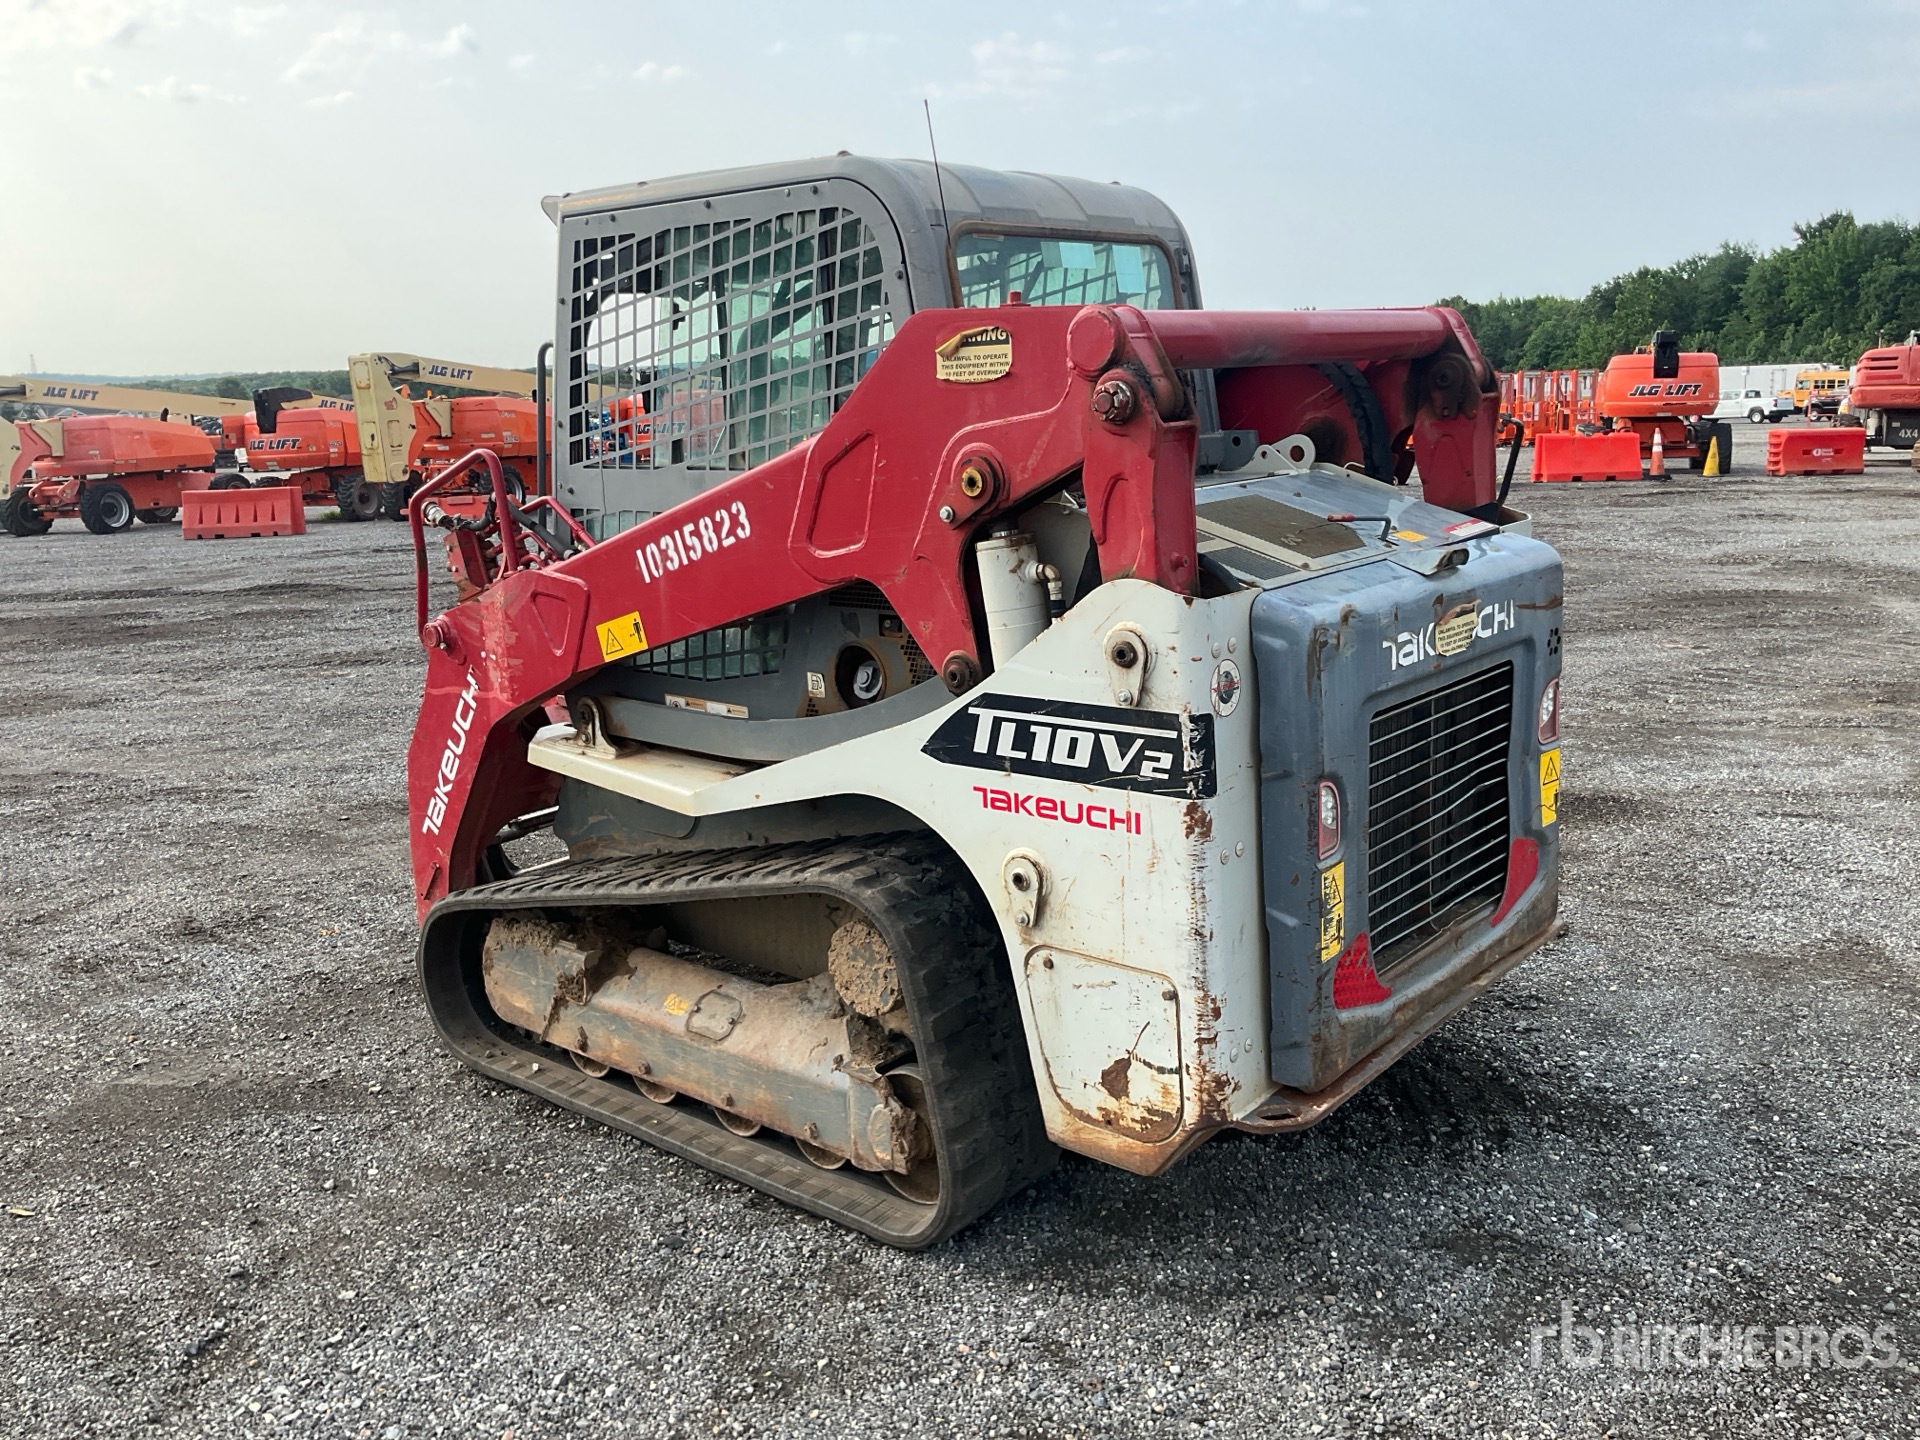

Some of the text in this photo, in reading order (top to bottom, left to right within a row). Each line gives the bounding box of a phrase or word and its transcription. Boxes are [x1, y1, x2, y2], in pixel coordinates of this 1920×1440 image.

[429, 364, 473, 380] JLG LIFT
[42, 386, 99, 400] JLG LIFT
[1627, 383, 1703, 397] JLG LIFT
[340, 402, 355, 411] LIF
[1899, 429, 1918, 438] 4X4
[268, 437, 301, 450] LIFT
[636, 501, 750, 584] 10315823
[968, 707, 1178, 780] TL10V2
[973, 786, 1142, 835] TAKEUCHI
